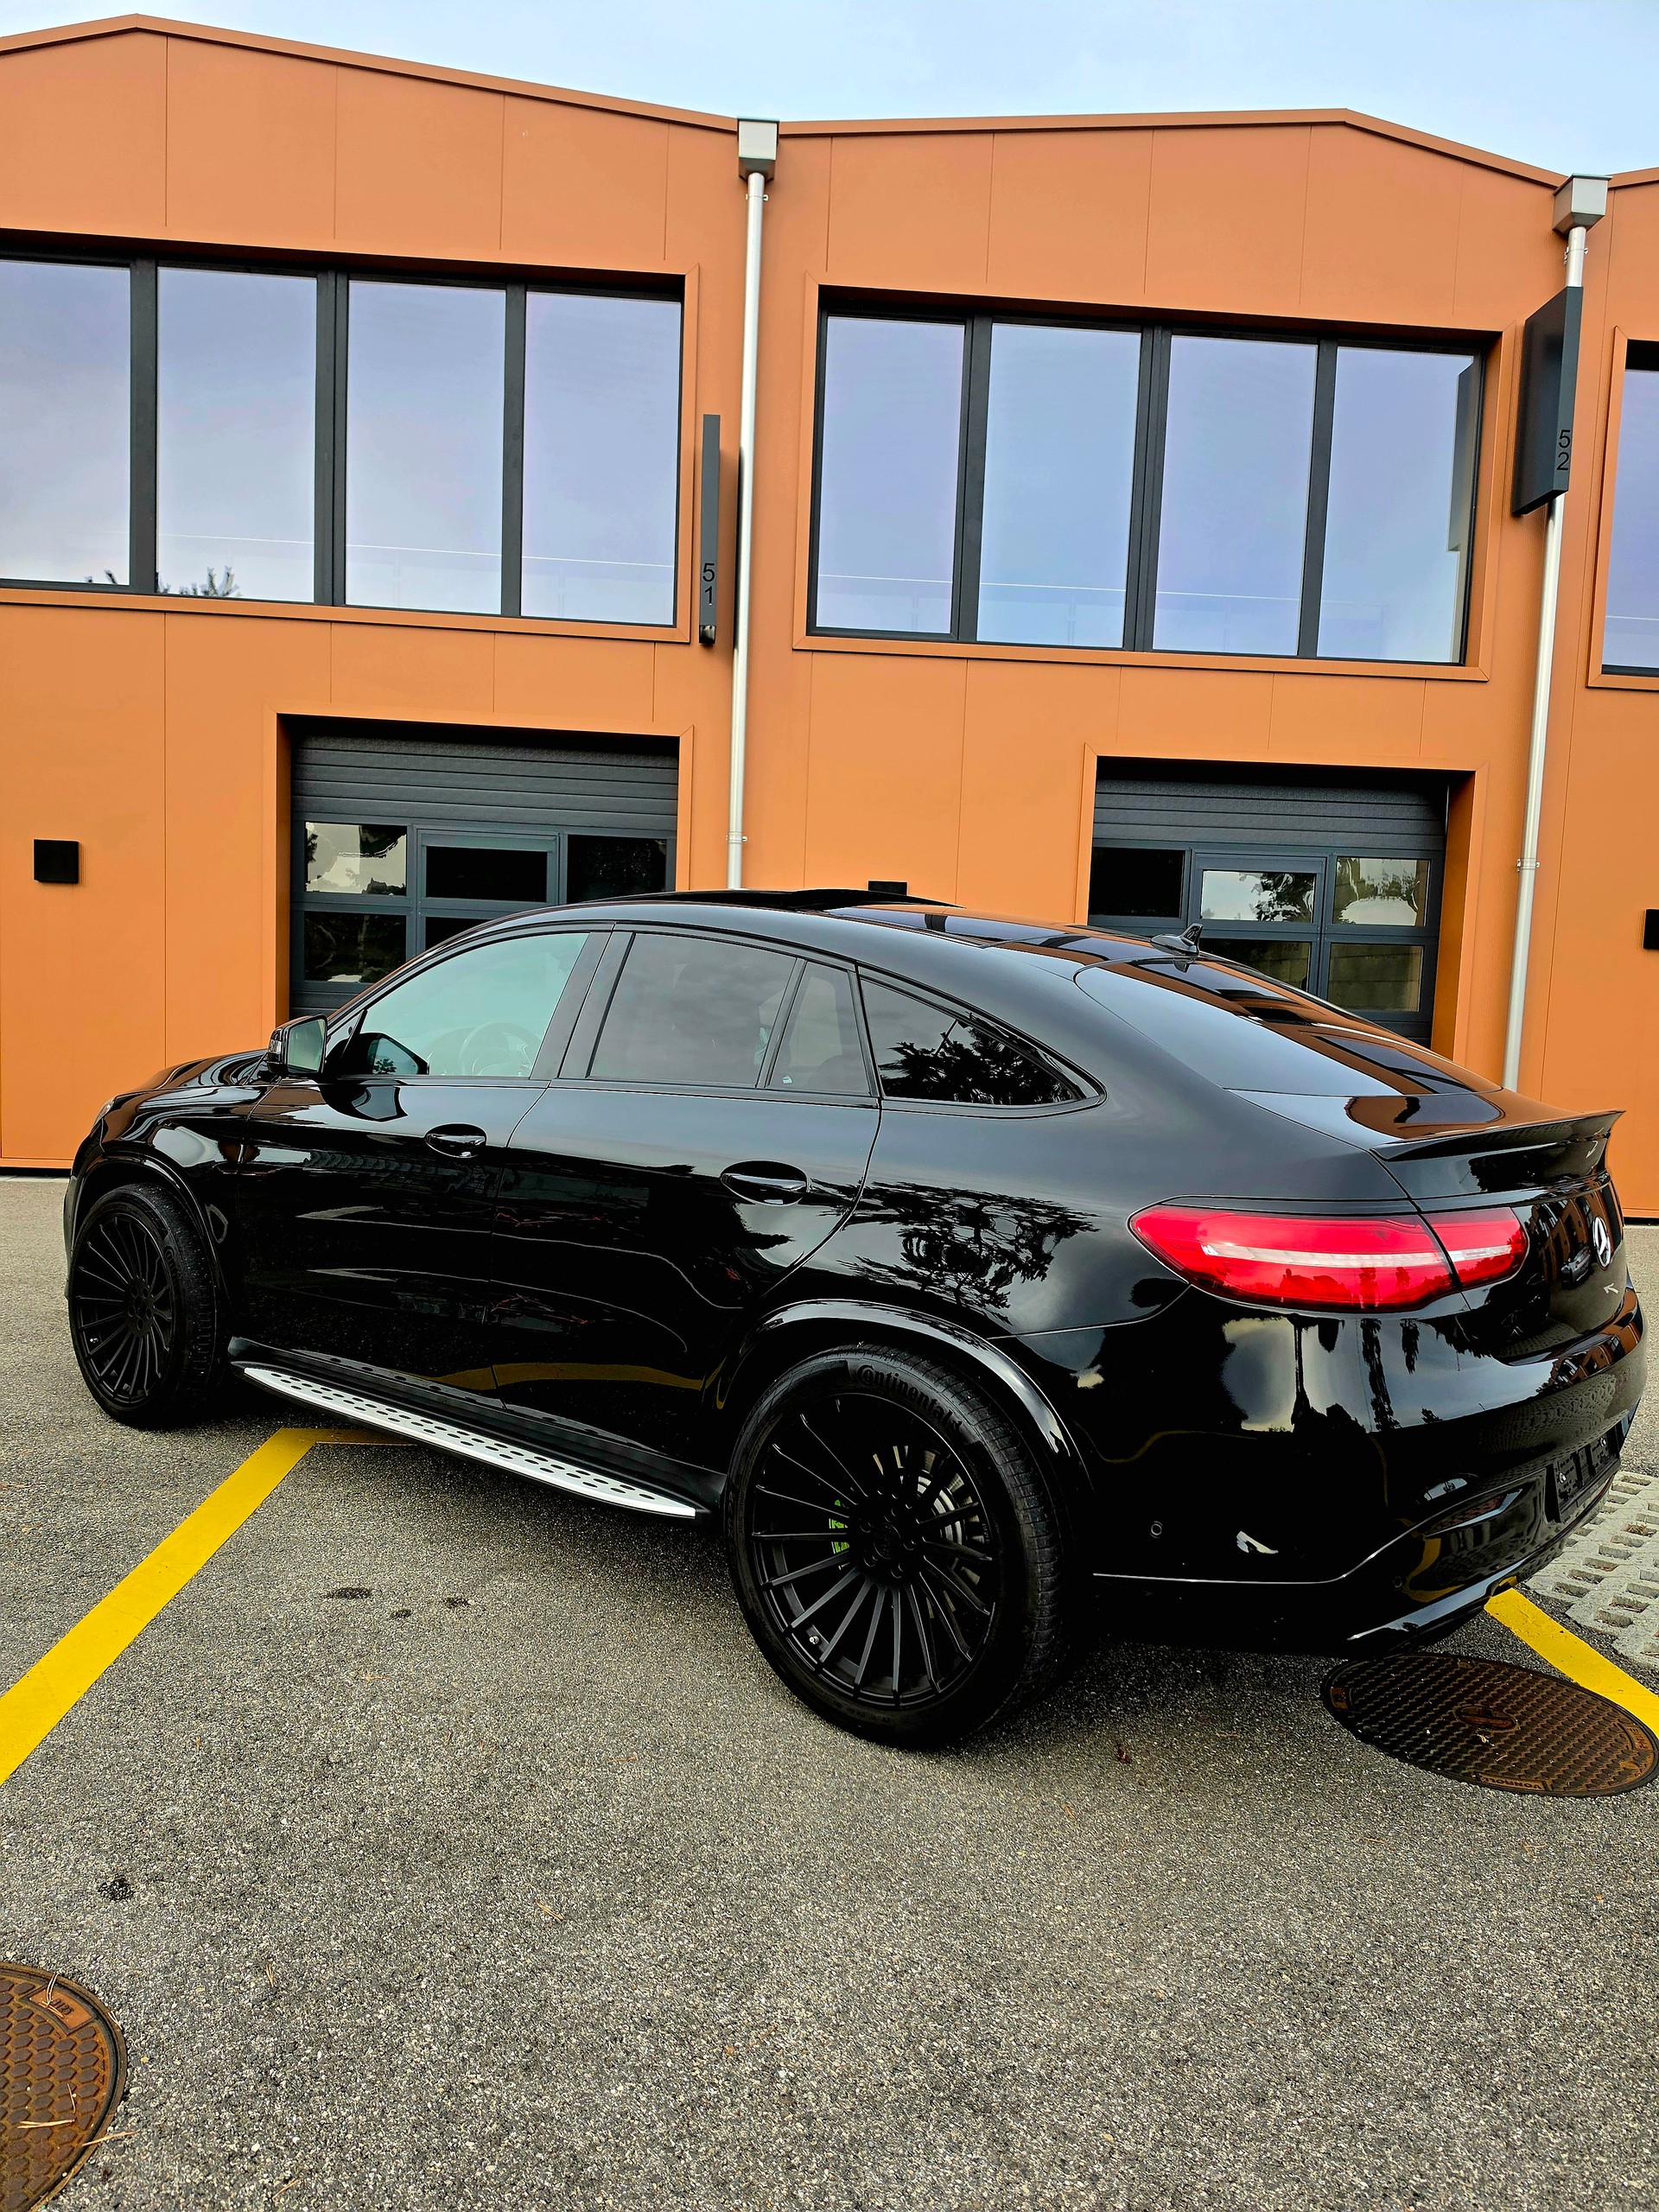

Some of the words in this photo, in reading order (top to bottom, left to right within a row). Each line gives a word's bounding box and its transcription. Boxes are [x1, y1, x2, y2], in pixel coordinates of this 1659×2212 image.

[1556, 429, 1571, 471] 52
[702, 563, 715, 604] 51
[856, 1364, 954, 1426] Continental
